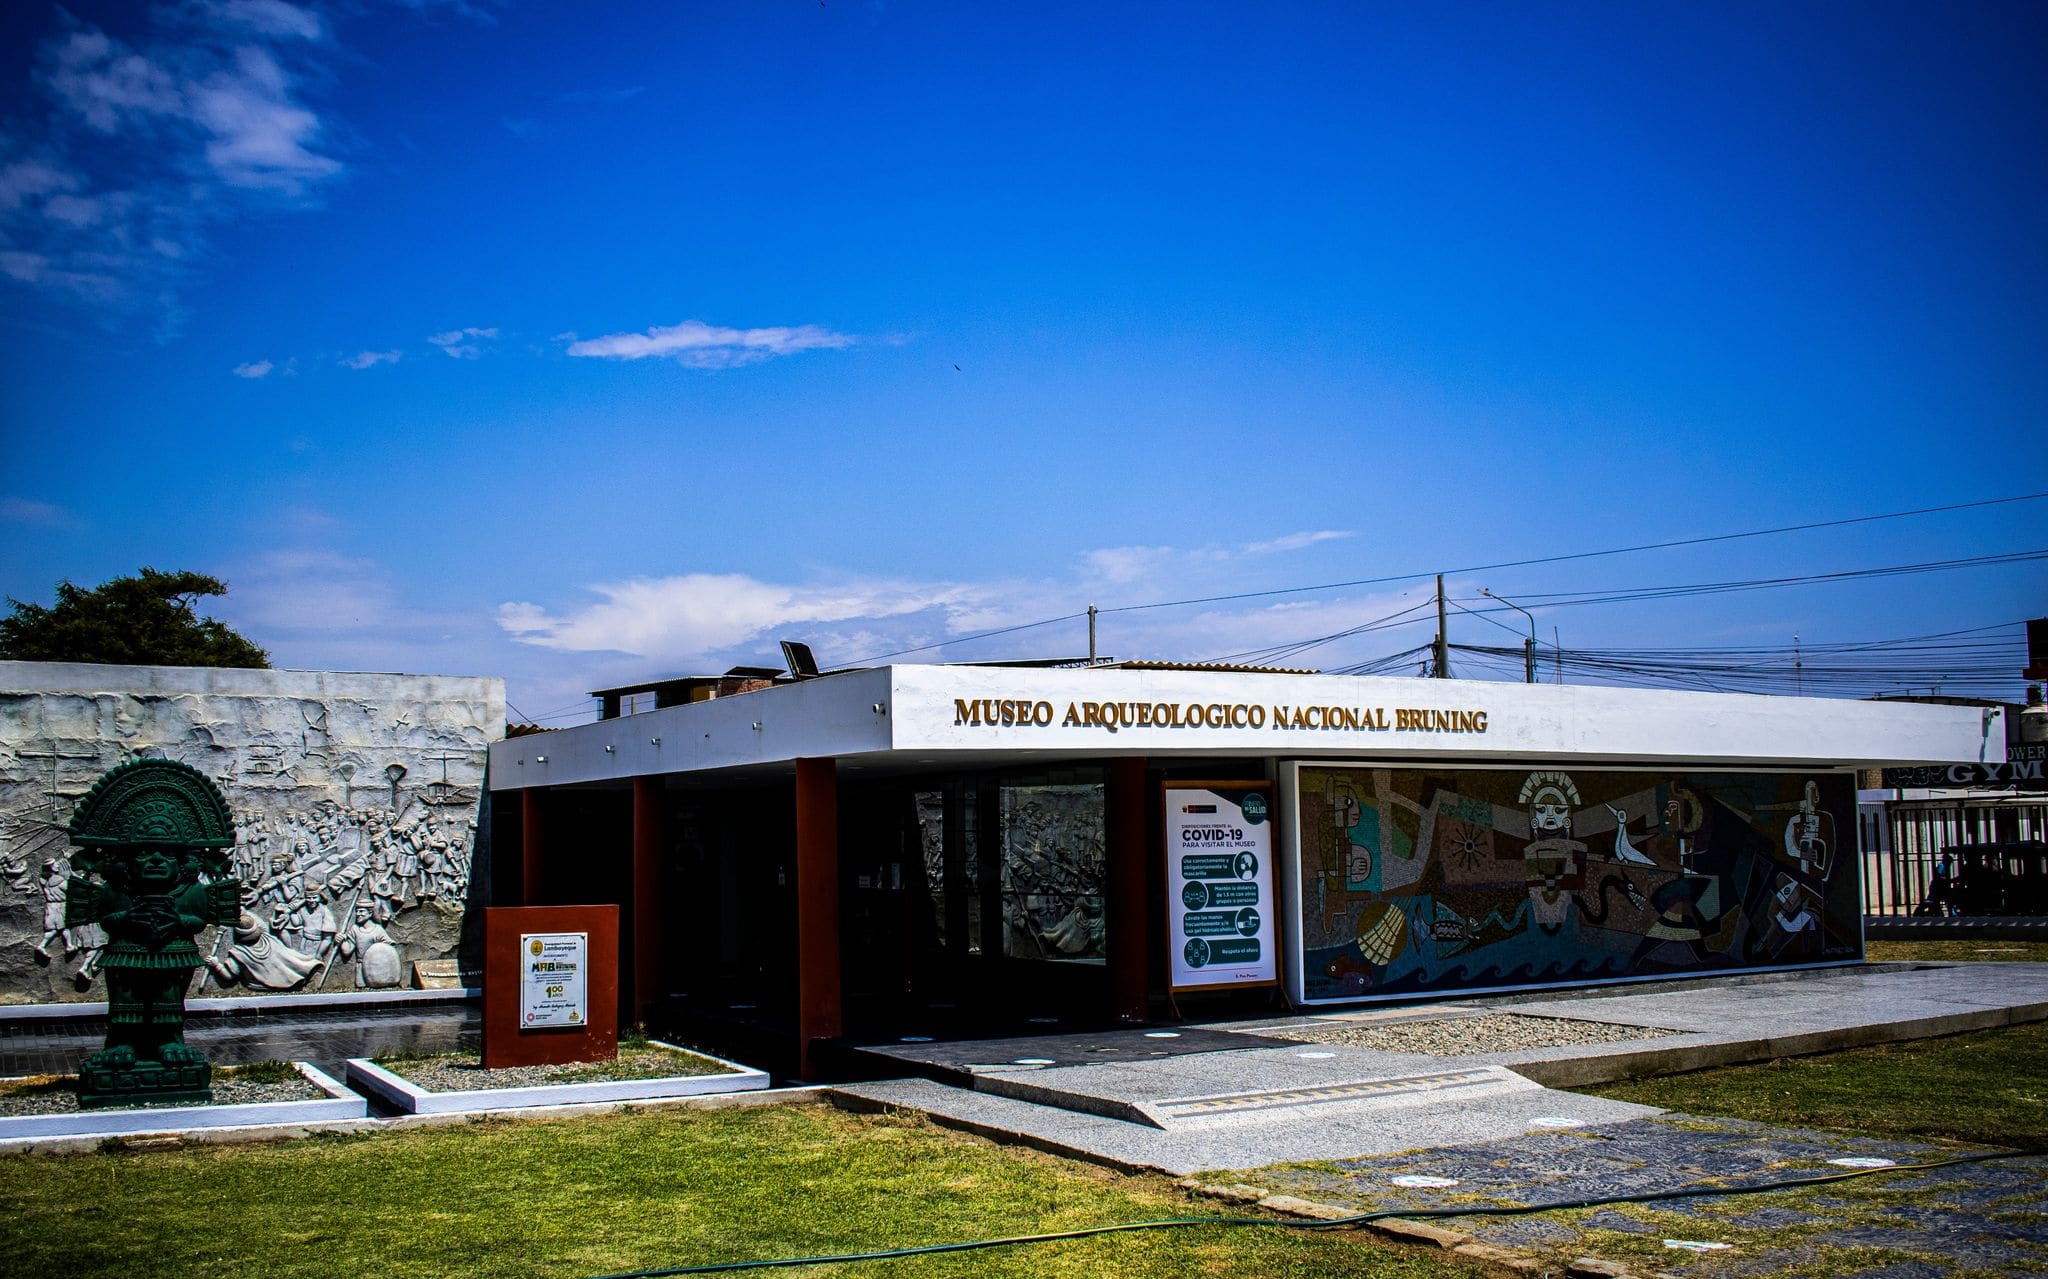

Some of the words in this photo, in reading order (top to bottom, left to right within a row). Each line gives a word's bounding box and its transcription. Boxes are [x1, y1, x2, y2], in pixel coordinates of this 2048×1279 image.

[954, 699, 1054, 727] MUSEO
[1061, 701, 1266, 732] ARQUEOLOGICO
[1273, 705, 1391, 732] NACIONAL
[1395, 708, 1489, 734] BRUNING
[2006, 746, 2047, 760] OWER
[1947, 762, 2047, 783] GYM
[1182, 829, 1243, 841] COVID-19
